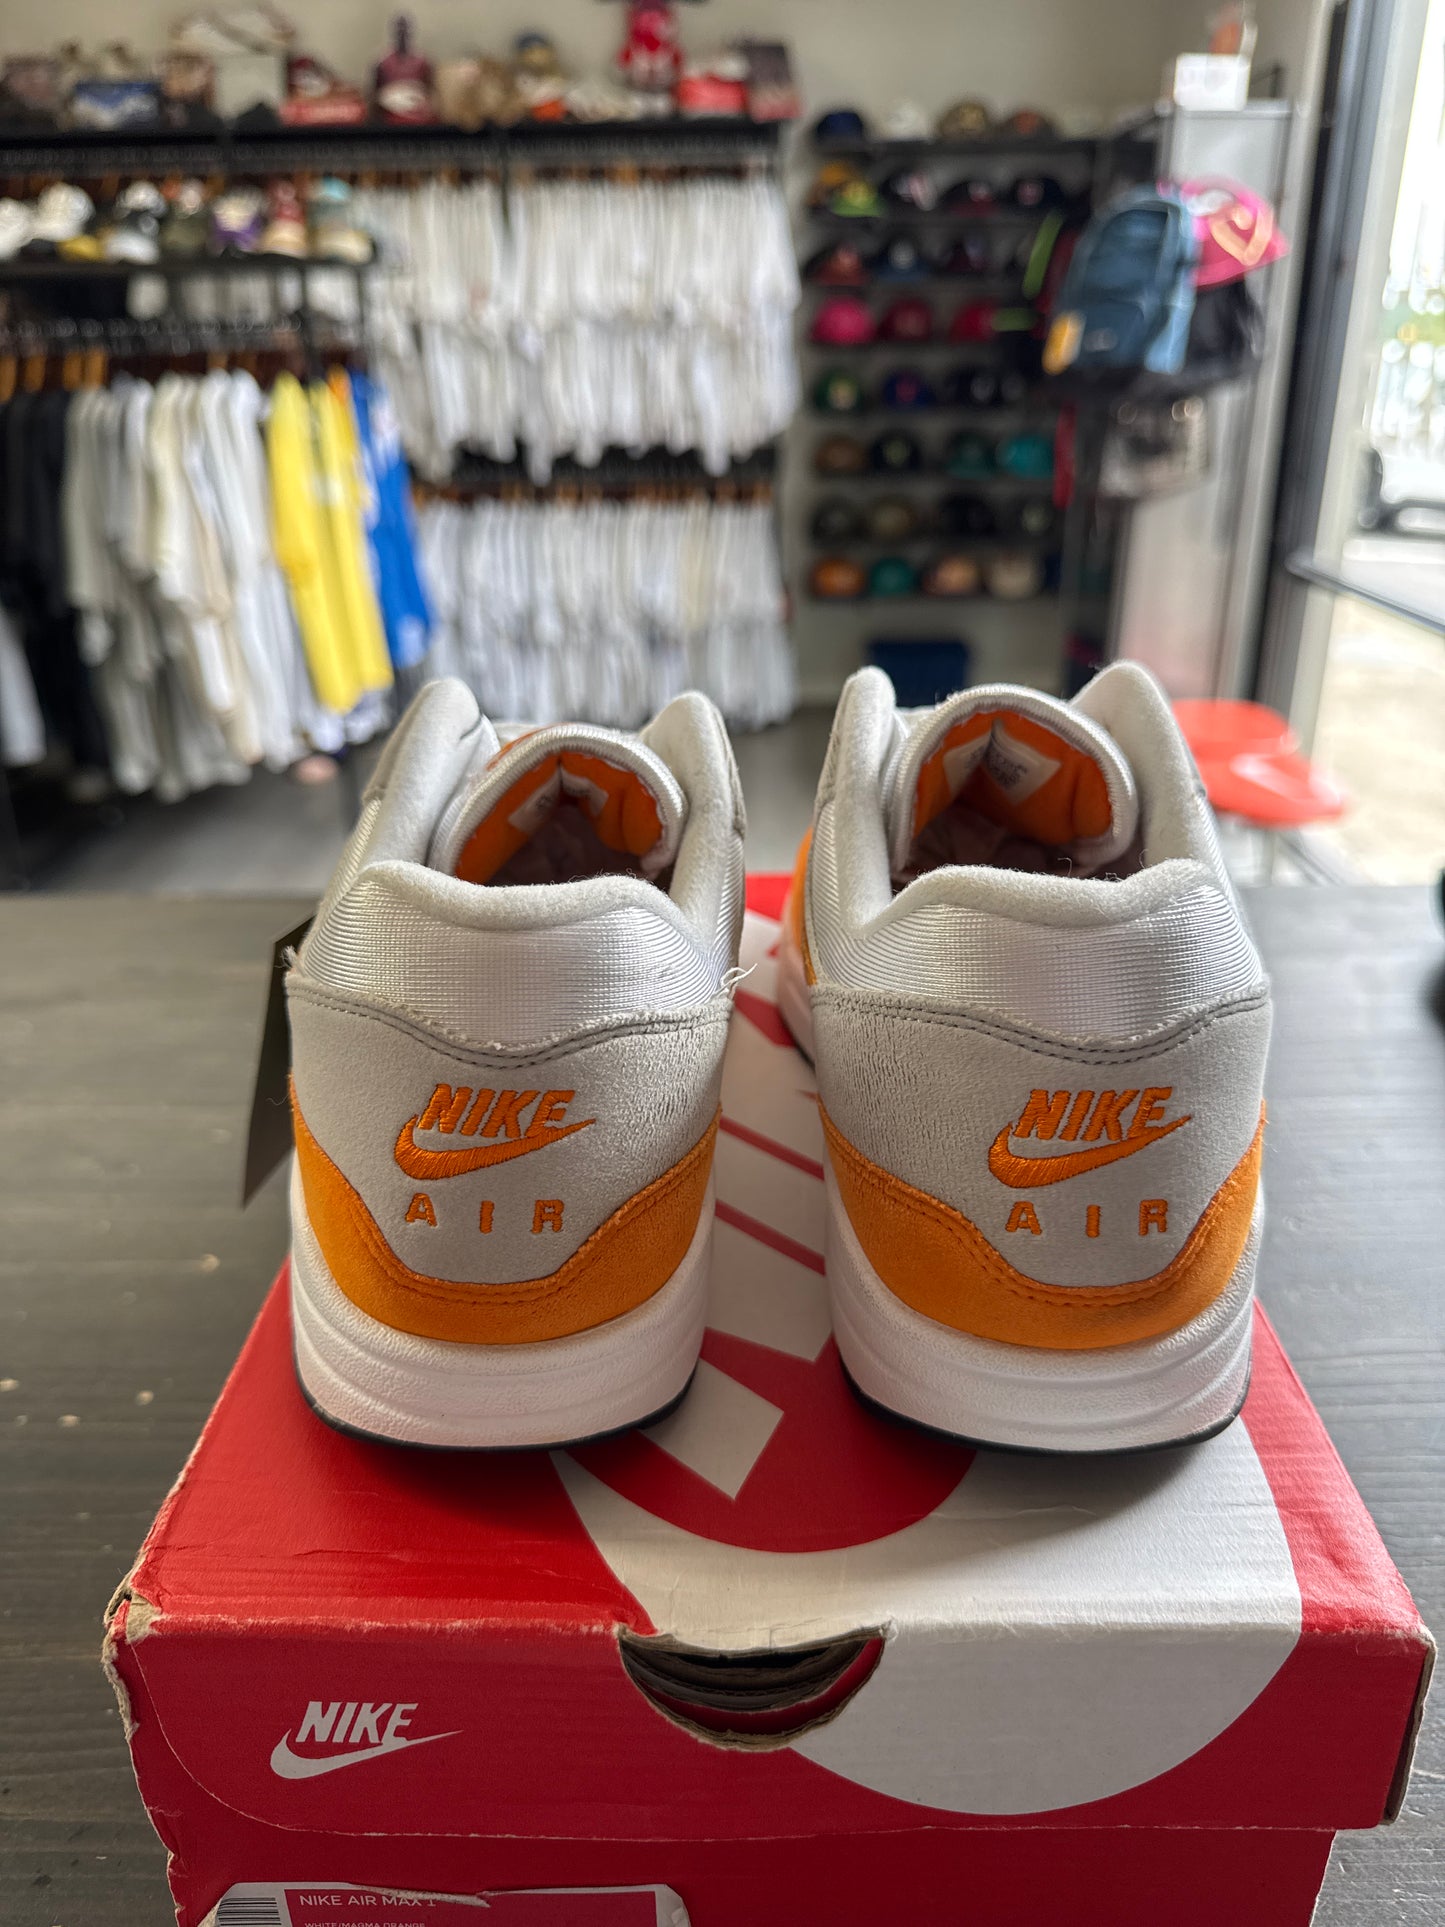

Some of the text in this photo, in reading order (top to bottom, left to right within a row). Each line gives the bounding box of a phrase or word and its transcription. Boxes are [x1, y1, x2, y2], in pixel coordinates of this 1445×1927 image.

[417, 1083, 576, 1138] NIKE
[1012, 1086, 1173, 1141] NIKE
[404, 1192, 565, 1235] AIR
[1004, 1199, 1169, 1238] AIR
[295, 1700, 419, 1746] NIKE
[299, 1894, 342, 1906] NIKE
[347, 1894, 378, 1906] AIR
[381, 1894, 422, 1907] MAX
